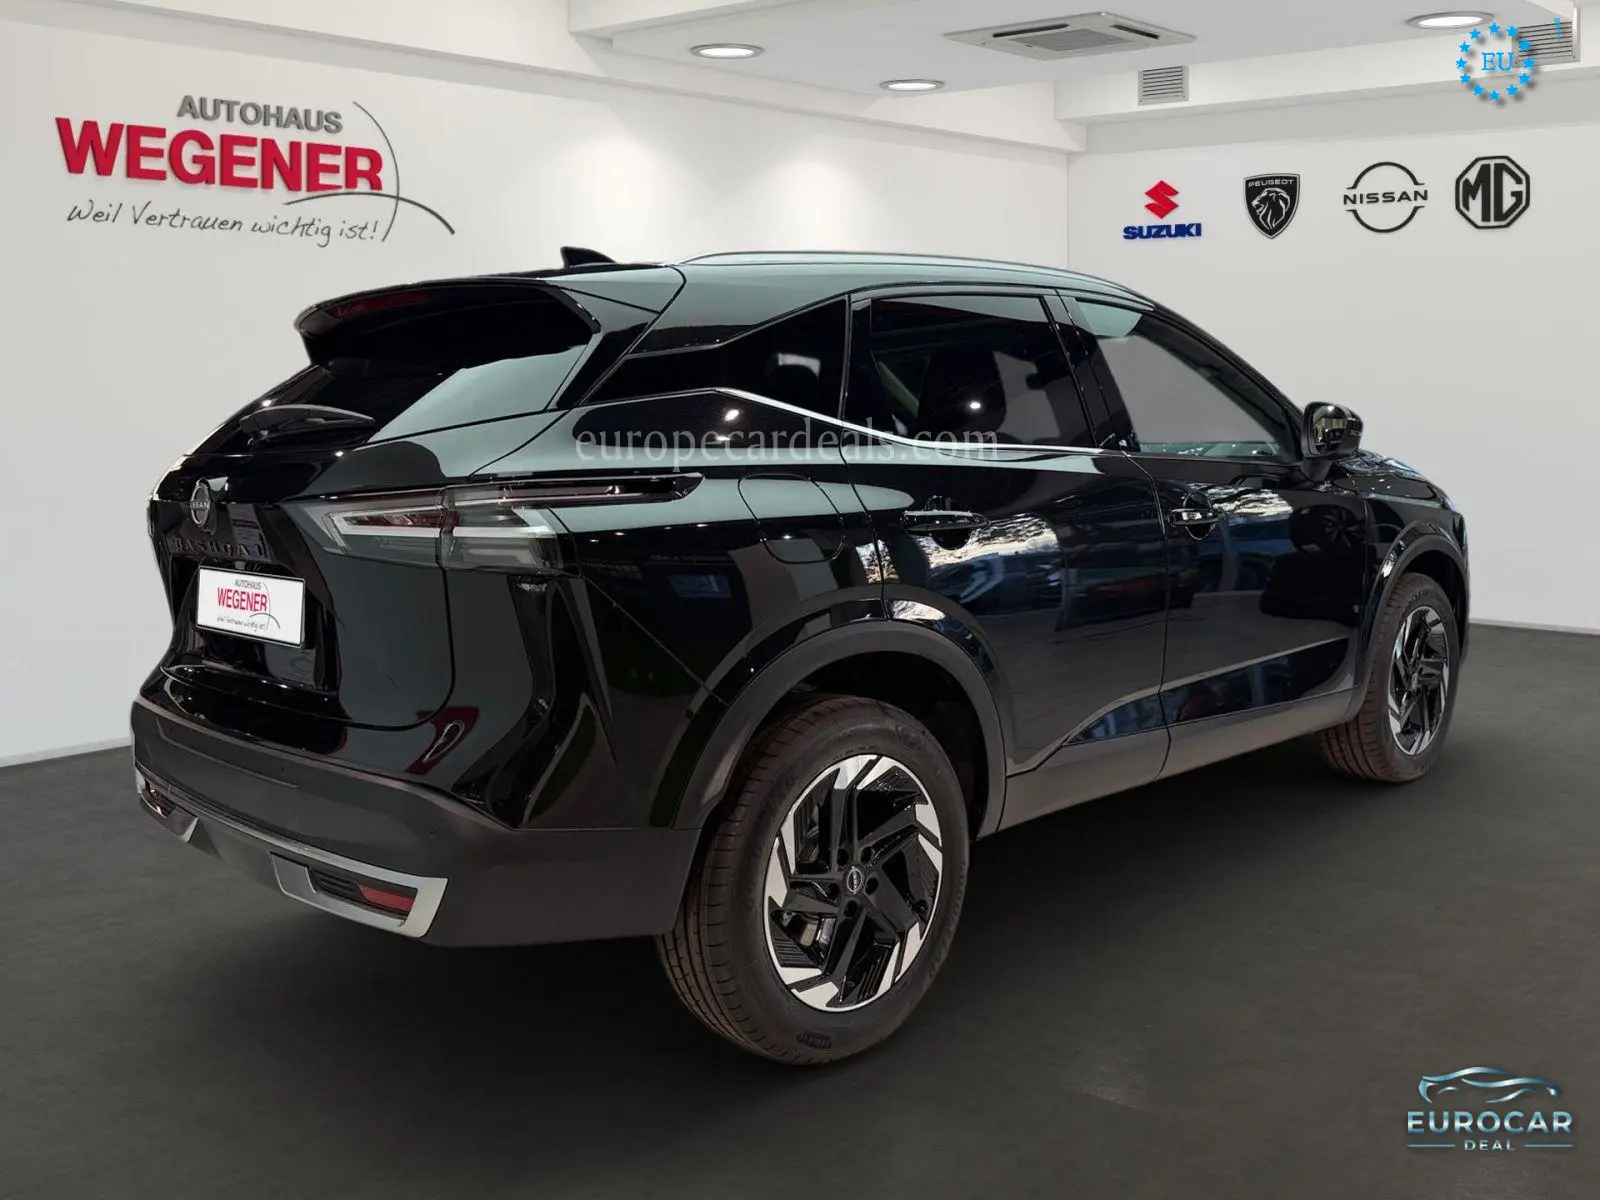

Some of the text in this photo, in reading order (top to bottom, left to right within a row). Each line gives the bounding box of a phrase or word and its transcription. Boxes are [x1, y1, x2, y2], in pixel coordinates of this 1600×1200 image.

[176, 94, 343, 135] AUTOHAUS
[55, 116, 384, 193] WEGENER
[1247, 177, 1295, 188] PEUGEOT
[1343, 189, 1428, 206] NISSAN
[1461, 162, 1525, 224] MG
[66, 198, 379, 249] Weil Vertrauen wichtig ist!
[1123, 222, 1203, 241] SUZUKI
[217, 587, 268, 612] WEGENER
